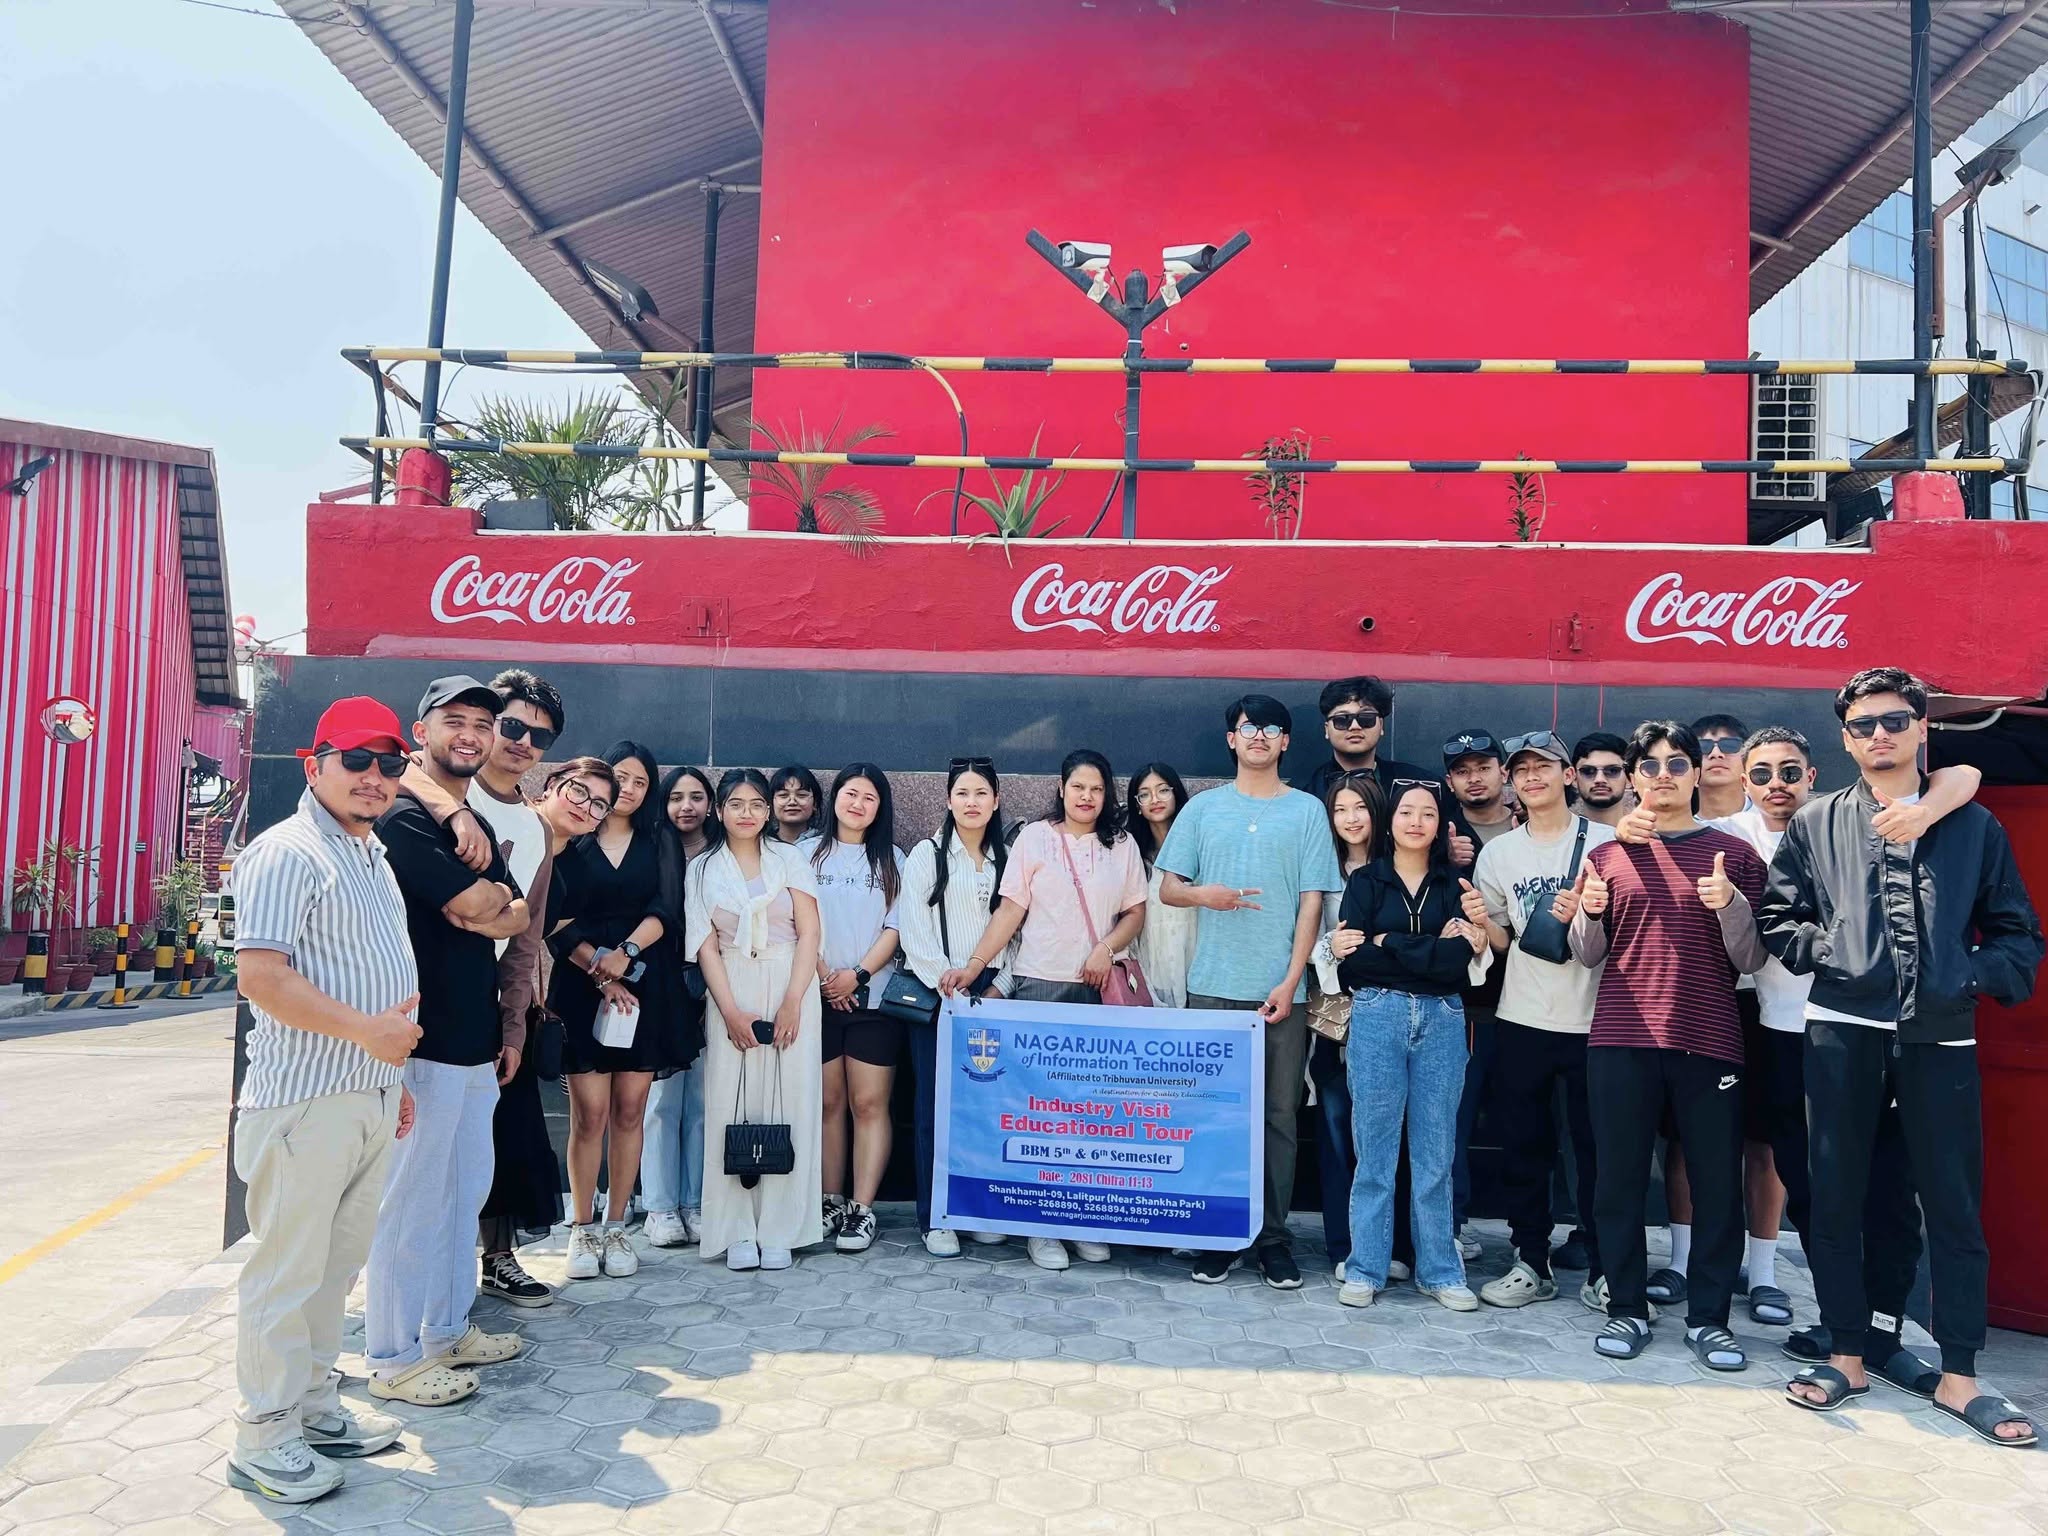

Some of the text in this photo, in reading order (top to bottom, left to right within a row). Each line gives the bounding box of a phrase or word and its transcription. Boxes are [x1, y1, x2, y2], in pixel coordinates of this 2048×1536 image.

[430, 554, 644, 627] Coca-Cola
[1011, 562, 1233, 635] Coca-Cola
[1625, 572, 1864, 648] Coca-Cola
[1014, 1032, 1233, 1059] NAGARJUNA COLLEGE
[1021, 1051, 1224, 1077] of Information Technology
[1047, 1070, 1197, 1088] (Affiliated to Tribhuvan University)
[1028, 1095, 1171, 1119] Industry Visit
[1000, 1113, 1194, 1142] Educational Tour
[1020, 1144, 1173, 1165] BBM 5th & 6th Semester
[1039, 1169, 1153, 1189] Date: 2081 Chitra 11-13
[988, 1184, 1206, 1210] Shankhamul-09, Lalitpur (Near Shankha Park)
[1003, 1195, 1016, 1205] Ph
[1038, 1199, 1082, 1212] 5268890,
[1084, 1203, 1129, 1215] 5268894,
[1130, 1207, 1191, 1219] 98510-73795
[1040, 1209, 1150, 1225] www.nagarjunacollege.edu.np
